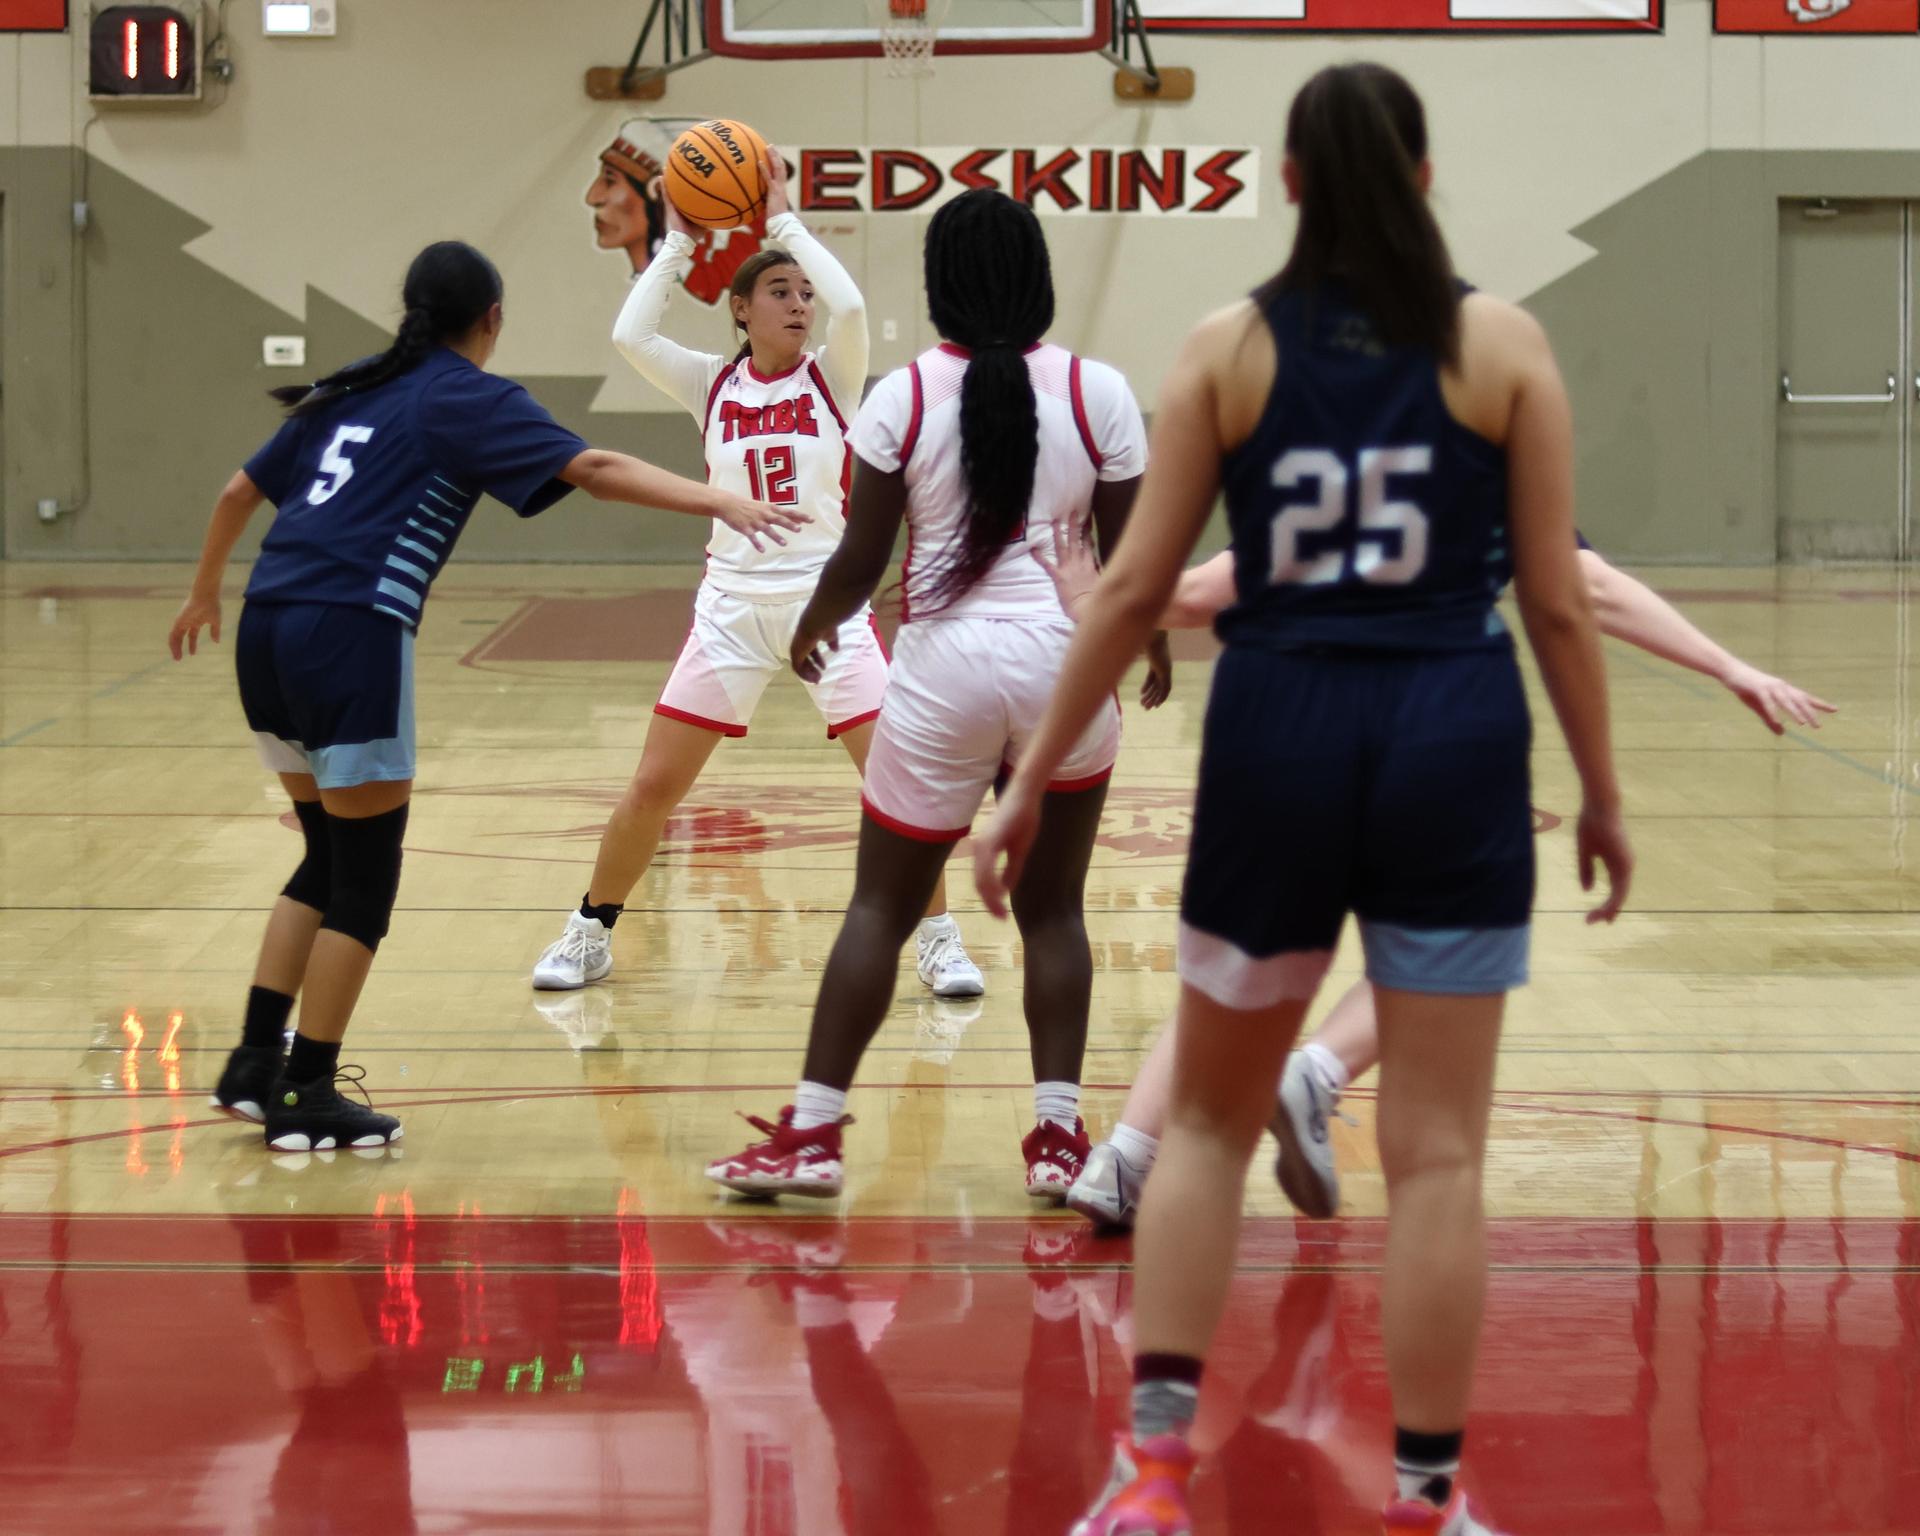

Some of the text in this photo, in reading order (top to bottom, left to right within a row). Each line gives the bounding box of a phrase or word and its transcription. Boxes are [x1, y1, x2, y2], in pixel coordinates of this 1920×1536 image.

[125, 20, 178, 79] 11
[676, 139, 715, 178] NCAA
[785, 148, 1252, 212] EDSKINS
[719, 393, 820, 443] TRIBE
[306, 425, 375, 505] 5
[744, 446, 798, 505] 12
[1268, 446, 1433, 584] 25
